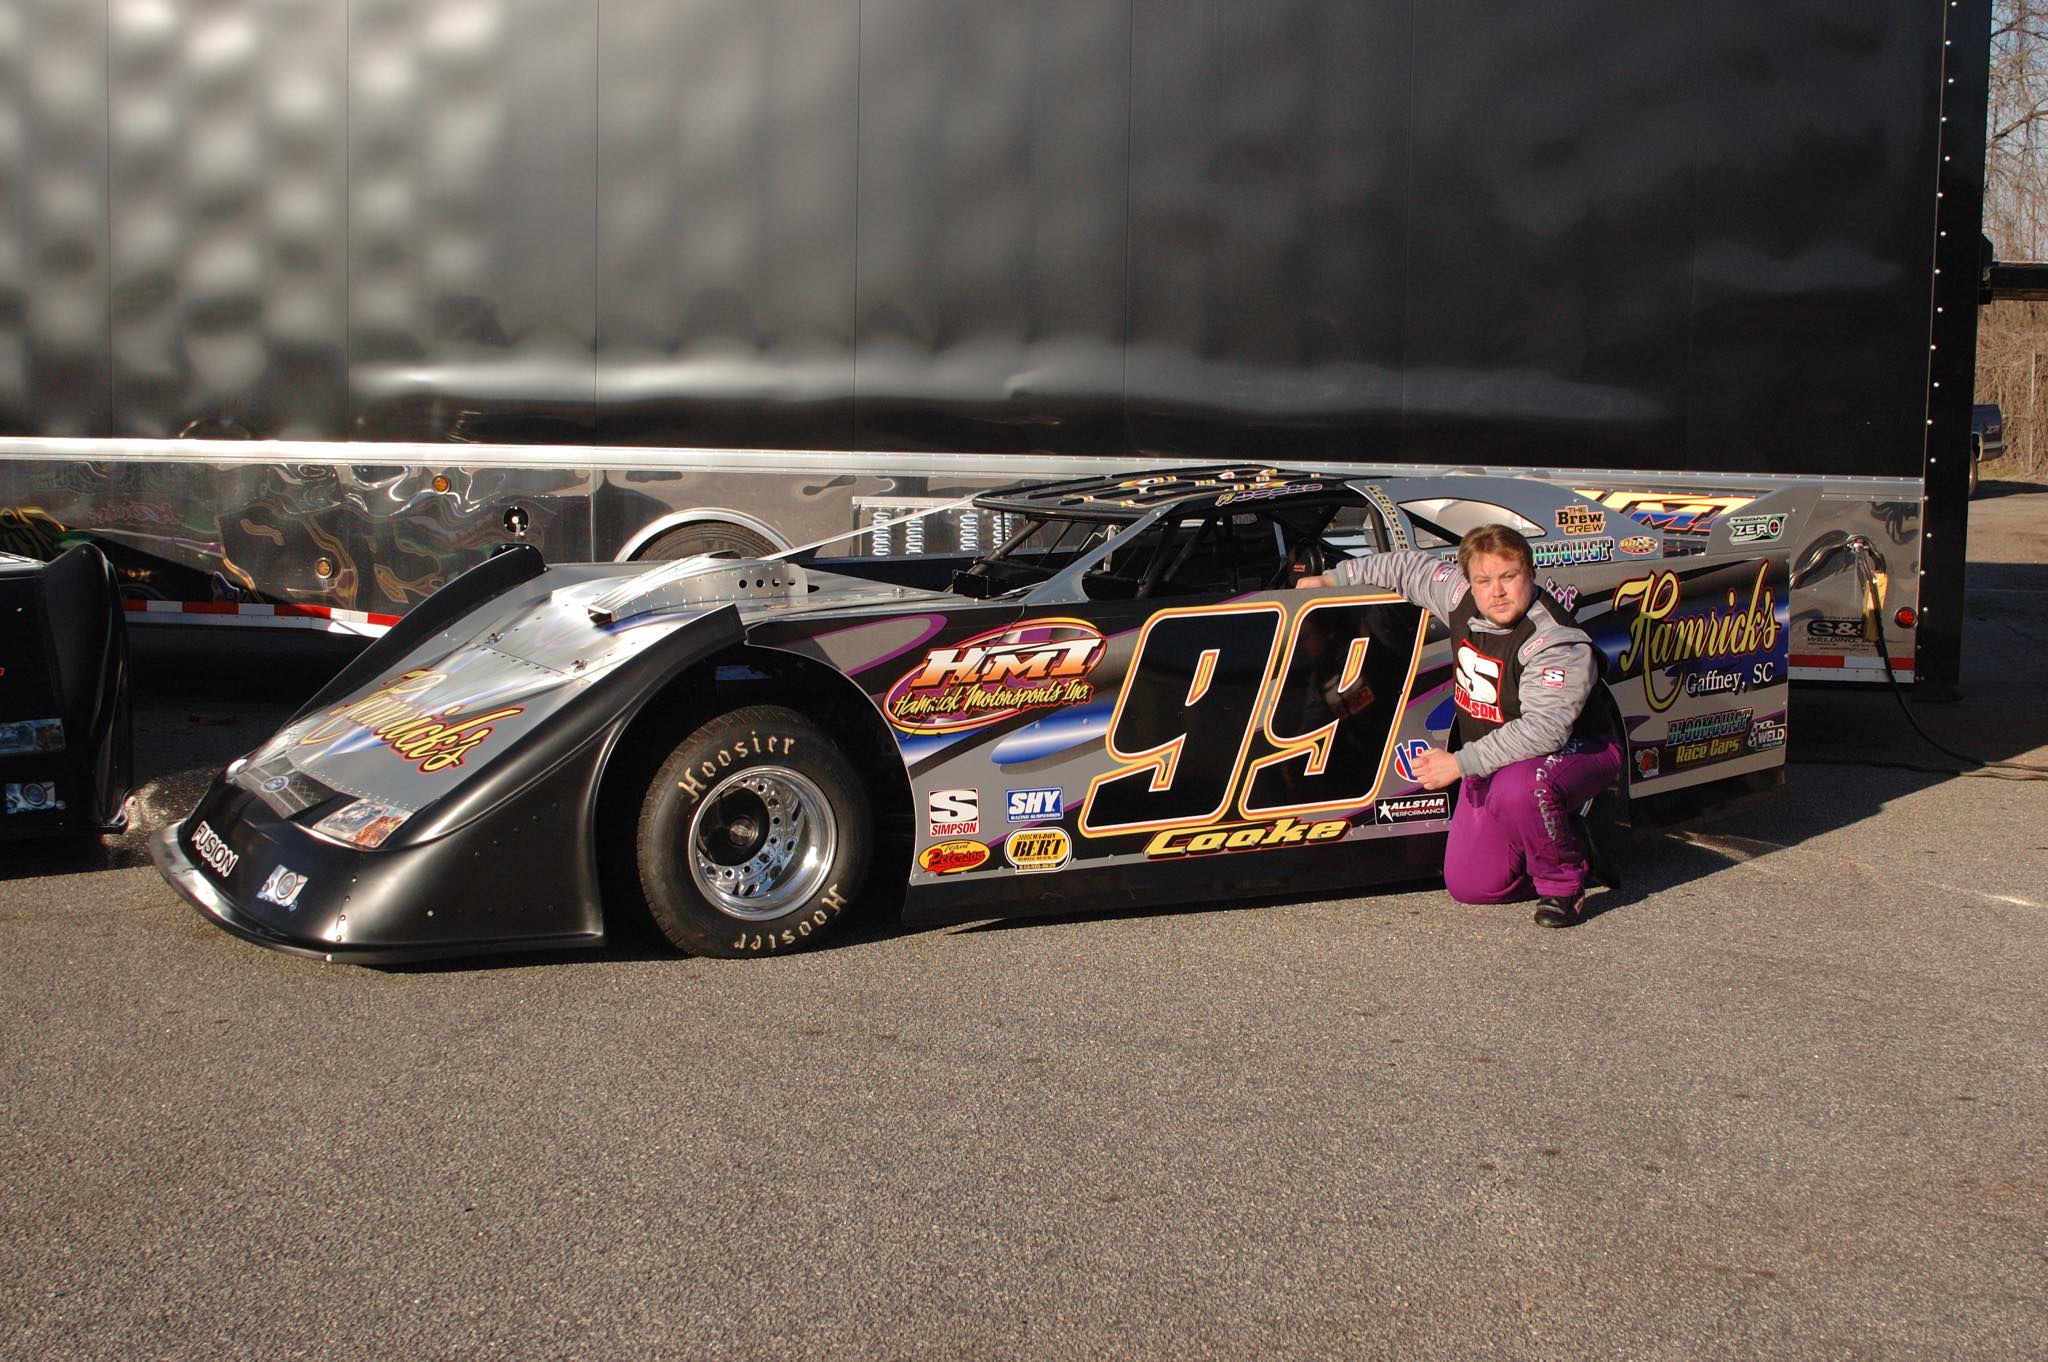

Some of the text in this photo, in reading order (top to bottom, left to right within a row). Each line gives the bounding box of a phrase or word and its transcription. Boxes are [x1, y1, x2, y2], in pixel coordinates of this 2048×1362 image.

[1557, 512, 1603, 525] Brew
[1565, 523, 1603, 534] CREW
[1614, 559, 1782, 712] Hamrick's
[1457, 646, 1499, 704] S
[1685, 661, 1774, 694] Gaffney, SC
[963, 680, 1064, 712] Motorsports
[1062, 678, 1089, 701] Inc.
[1455, 685, 1498, 721] SIMSON
[1079, 594, 1429, 838] 99
[1676, 738, 1740, 764] Race Cars
[1758, 728, 1785, 743] WELD
[678, 731, 795, 803] Hoosier
[929, 790, 978, 823] S
[1009, 791, 1060, 815] SHY
[1390, 798, 1445, 810] ALLSTAR
[1391, 807, 1446, 818] PERFORMANCE
[931, 822, 977, 836] SIMPSON
[1145, 818, 1349, 857] Cooke
[192, 821, 239, 878] FUSION
[1013, 838, 1066, 857] BERT
